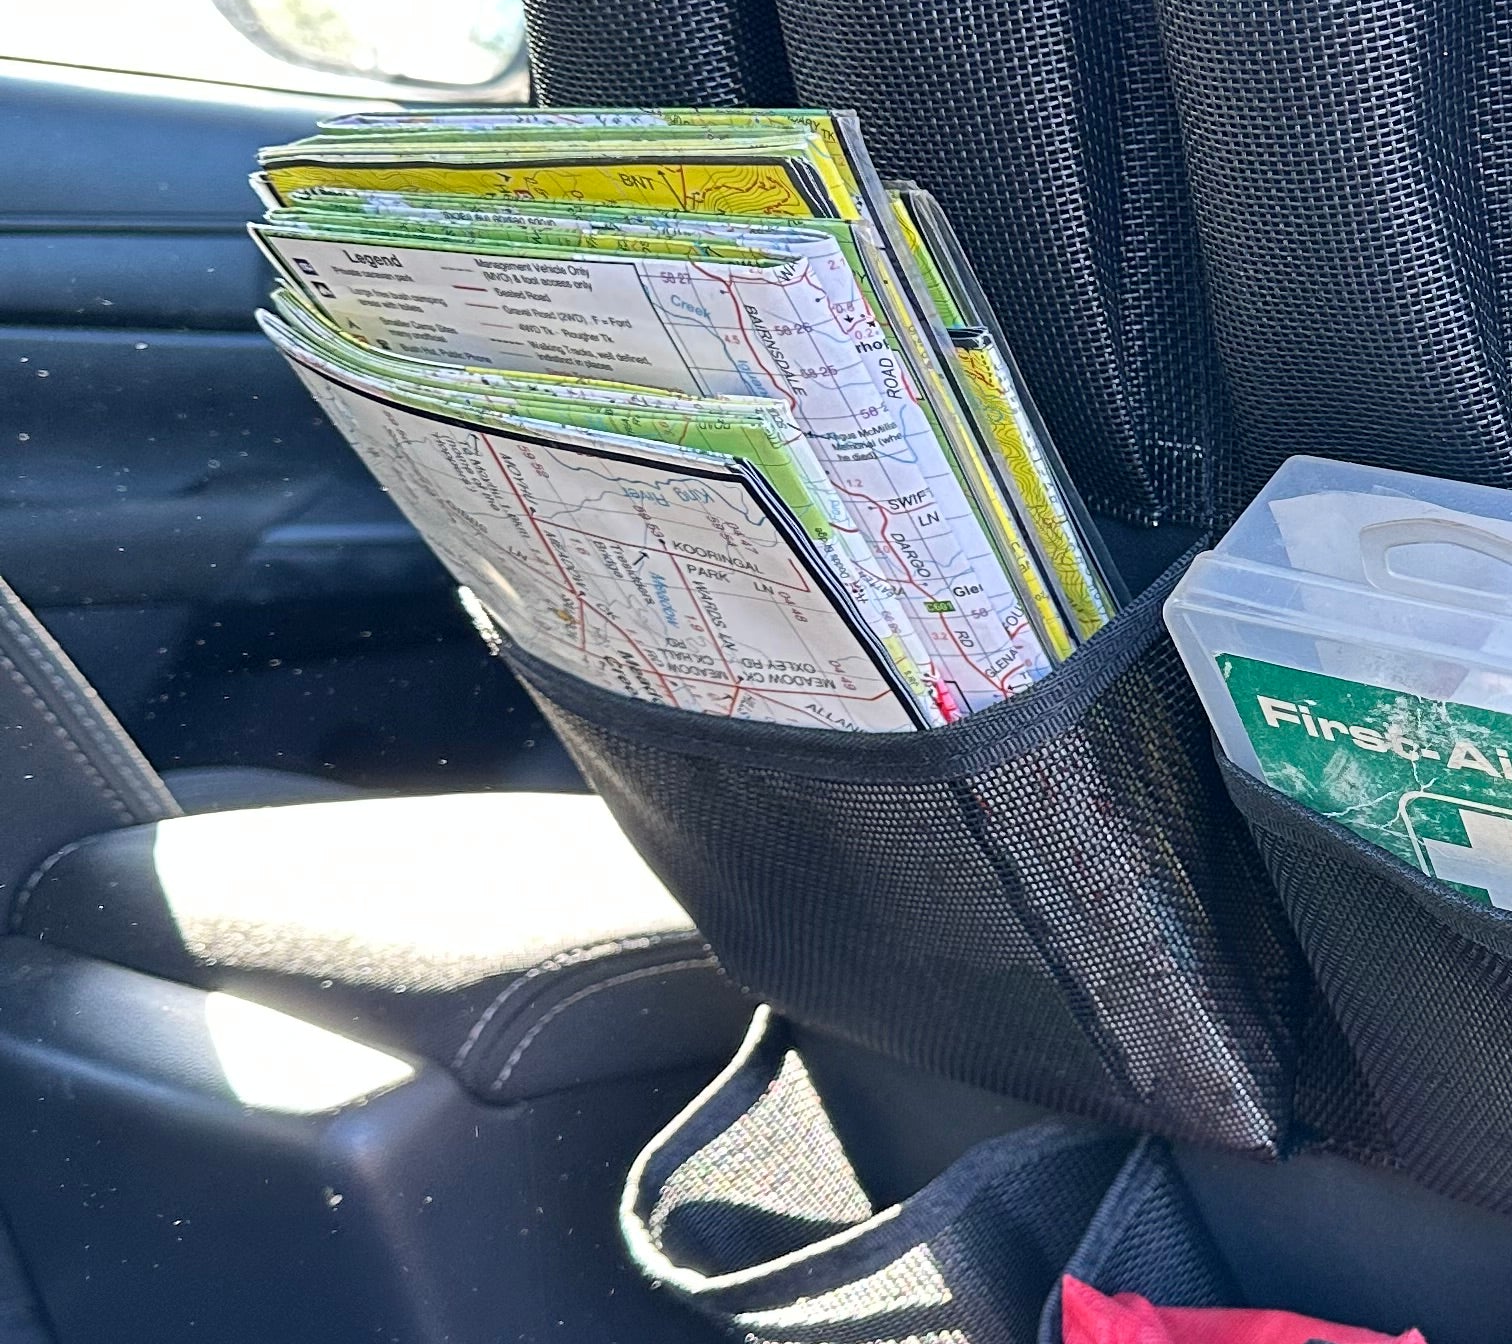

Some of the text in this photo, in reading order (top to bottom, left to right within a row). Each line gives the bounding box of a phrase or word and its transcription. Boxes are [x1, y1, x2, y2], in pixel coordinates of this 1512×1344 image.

[342, 249, 404, 268] Legend
[474, 258, 590, 279] Management Vehicle Only
[524, 291, 552, 303] Road
[670, 293, 711, 319] Creek
[531, 307, 557, 320] Road
[608, 317, 633, 329] Ford
[744, 304, 808, 397] BAIRNSDALE
[878, 357, 904, 399] ROAD
[620, 485, 716, 507] King River
[918, 510, 940, 527] LN
[672, 539, 765, 575] KOORINGAL
[890, 533, 931, 578] DARGO
[686, 563, 731, 584] PARK
[753, 581, 775, 595] LN
[692, 580, 728, 630] WARDS
[955, 630, 974, 648] RD
[666, 662, 730, 681] MEADOW
[740, 657, 817, 674] OXLEY RD
[768, 673, 837, 690] MEADOW
